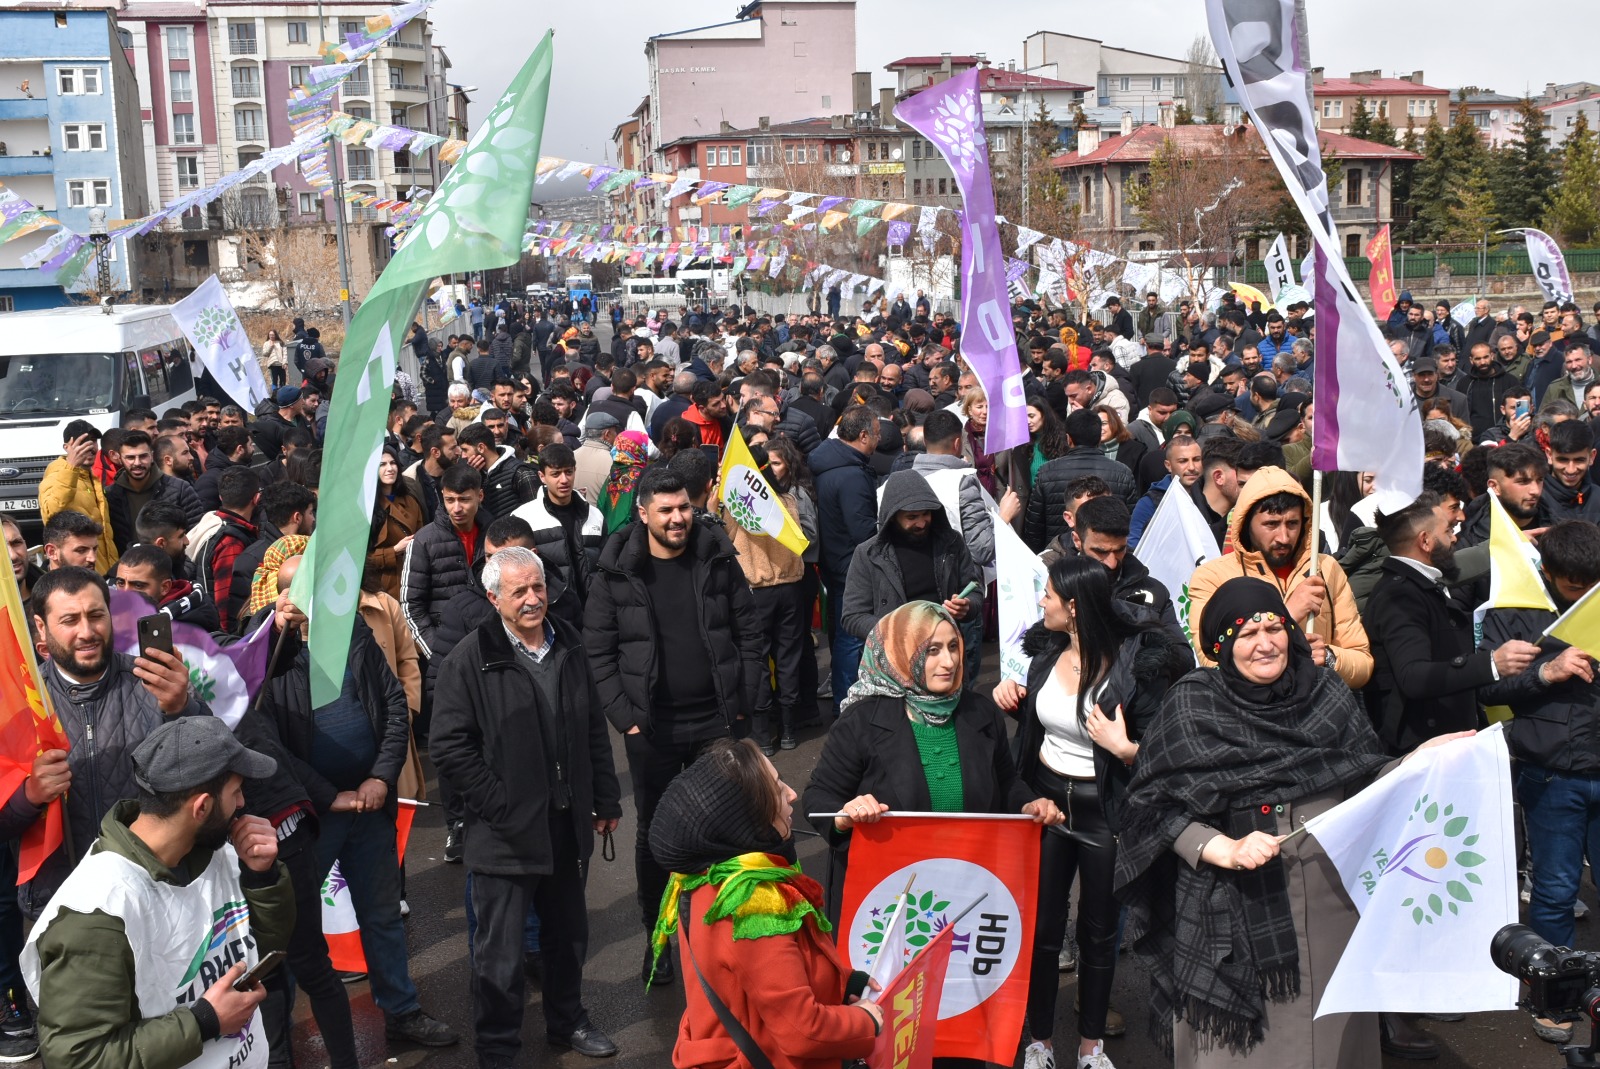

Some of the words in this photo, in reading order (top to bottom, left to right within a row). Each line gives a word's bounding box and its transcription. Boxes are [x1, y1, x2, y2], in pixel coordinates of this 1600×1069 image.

[4, 501, 16, 510] AZ
[20, 499, 38, 509] 409
[1006, 657, 1026, 677] SOL
[1358, 870, 1377, 896] PA
